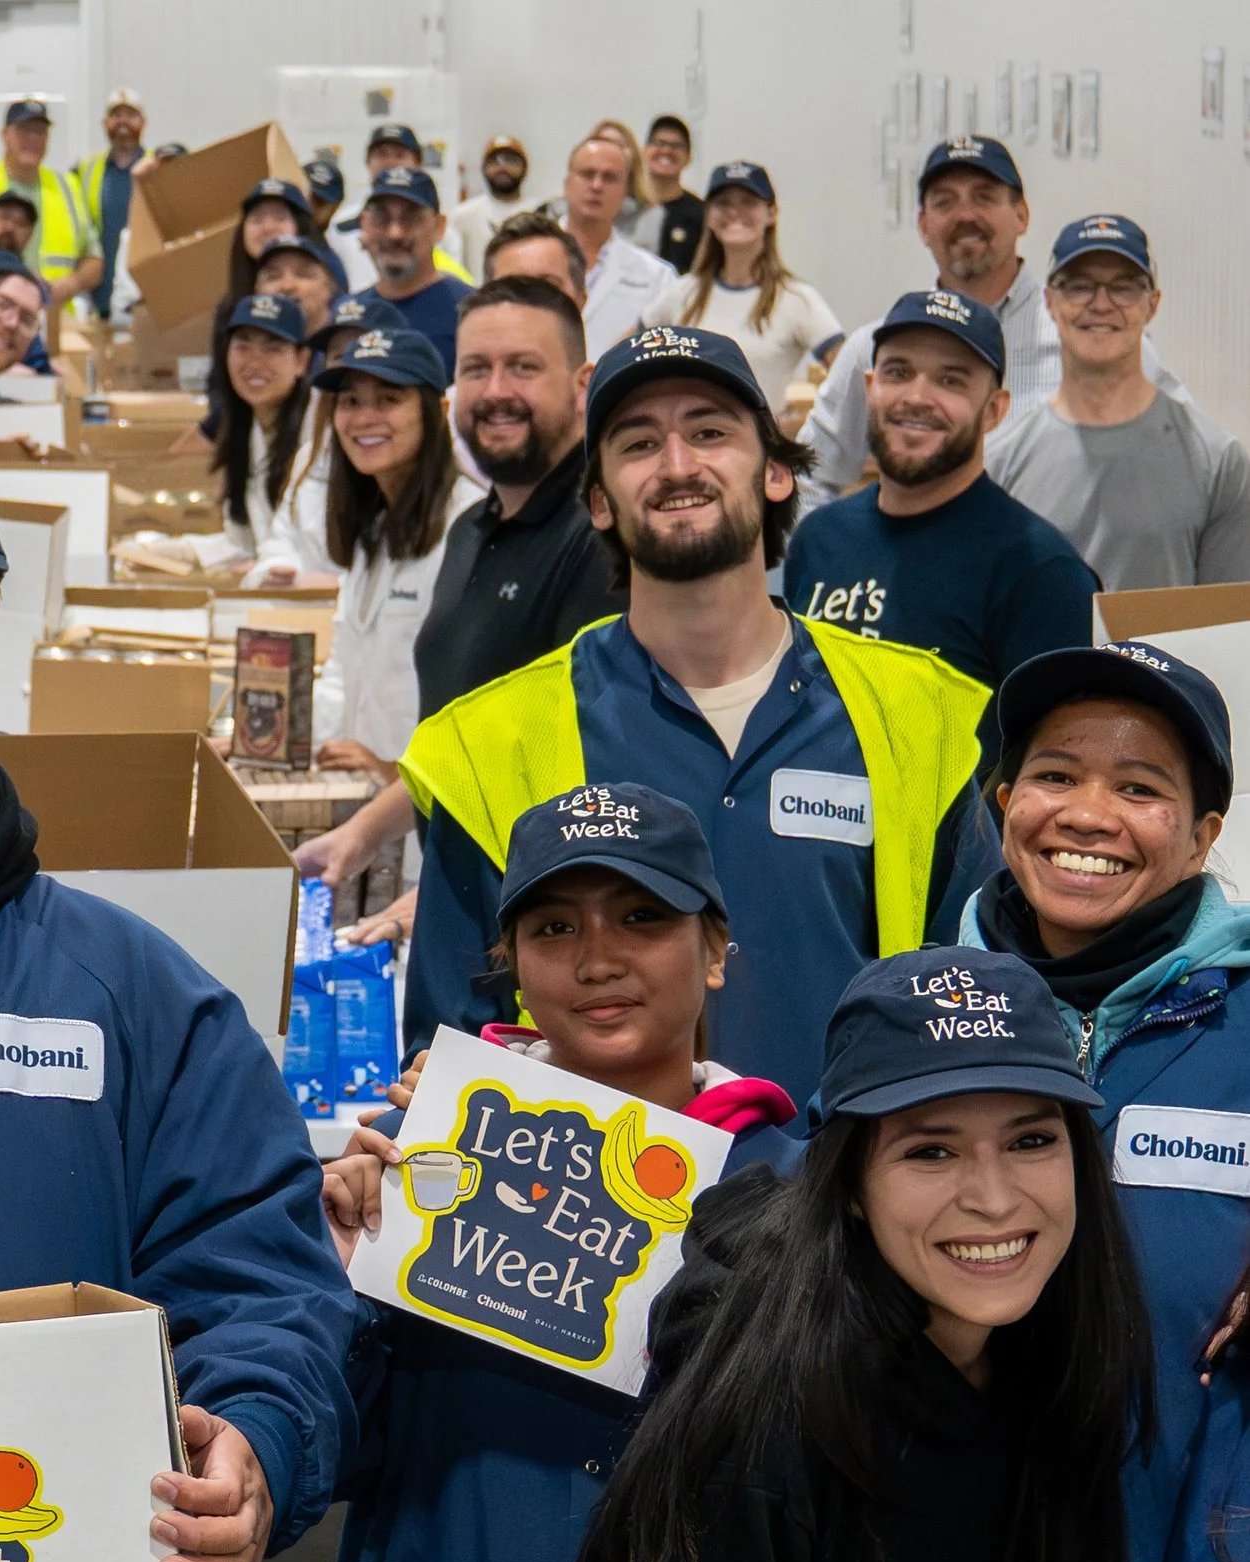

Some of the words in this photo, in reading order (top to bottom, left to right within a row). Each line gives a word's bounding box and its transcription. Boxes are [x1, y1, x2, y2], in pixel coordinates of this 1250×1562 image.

[665, 335, 699, 348] Eat
[806, 578, 887, 621] Let's
[557, 786, 611, 812] Let's
[597, 800, 640, 822] Eat
[779, 795, 866, 824] Chobani
[560, 819, 640, 841] Week
[910, 966, 975, 996] Let's
[963, 990, 1013, 1013] Eat
[925, 1013, 1016, 1041] Week
[471, 1105, 593, 1182] Let's
[1130, 1132, 1247, 1167] Chobani
[543, 1185, 636, 1266] Eat
[451, 1217, 594, 1315] Week
[427, 1277, 469, 1299] COLOMBE
[477, 1293, 528, 1321] Chobani
[535, 1318, 558, 1331] DAILY
[560, 1328, 596, 1345] HARVEST
